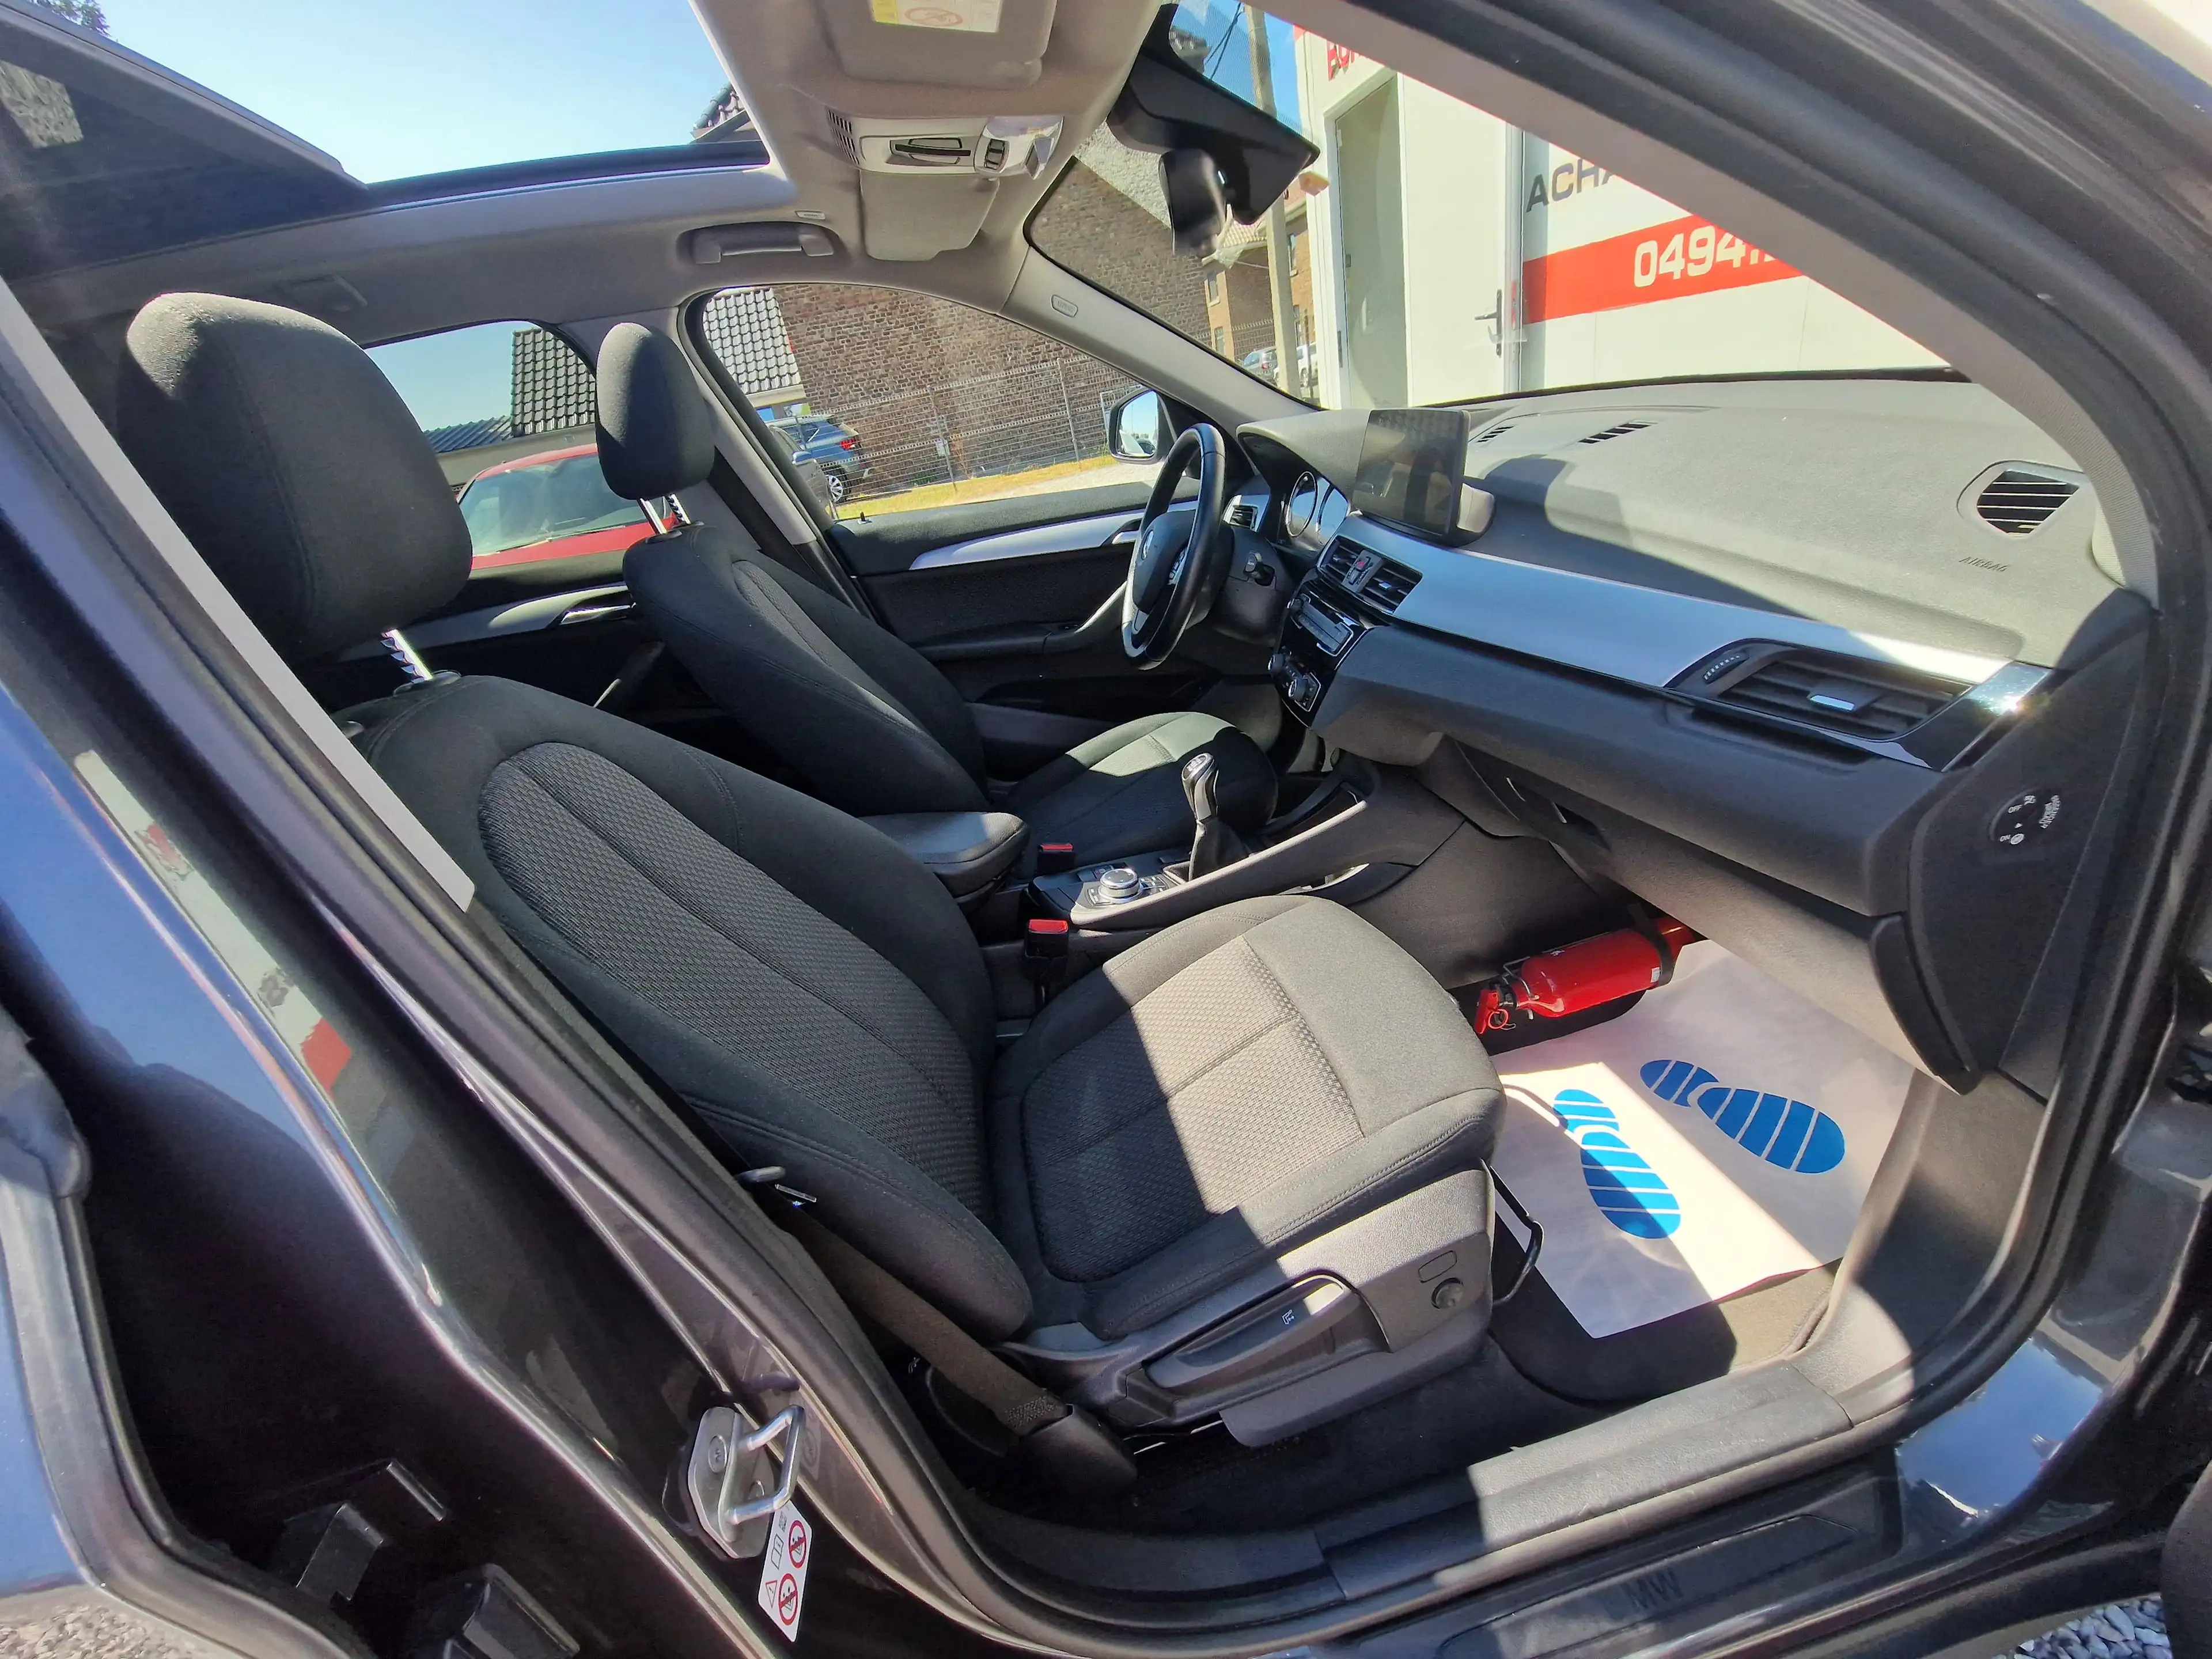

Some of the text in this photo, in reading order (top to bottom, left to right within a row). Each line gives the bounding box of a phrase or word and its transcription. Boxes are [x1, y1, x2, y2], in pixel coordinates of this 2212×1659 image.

[1526, 158, 1615, 213] ACH
[1634, 225, 1777, 287] 0494.
[2008, 804, 2022, 813] OFF
[1999, 834, 2011, 842] ON
